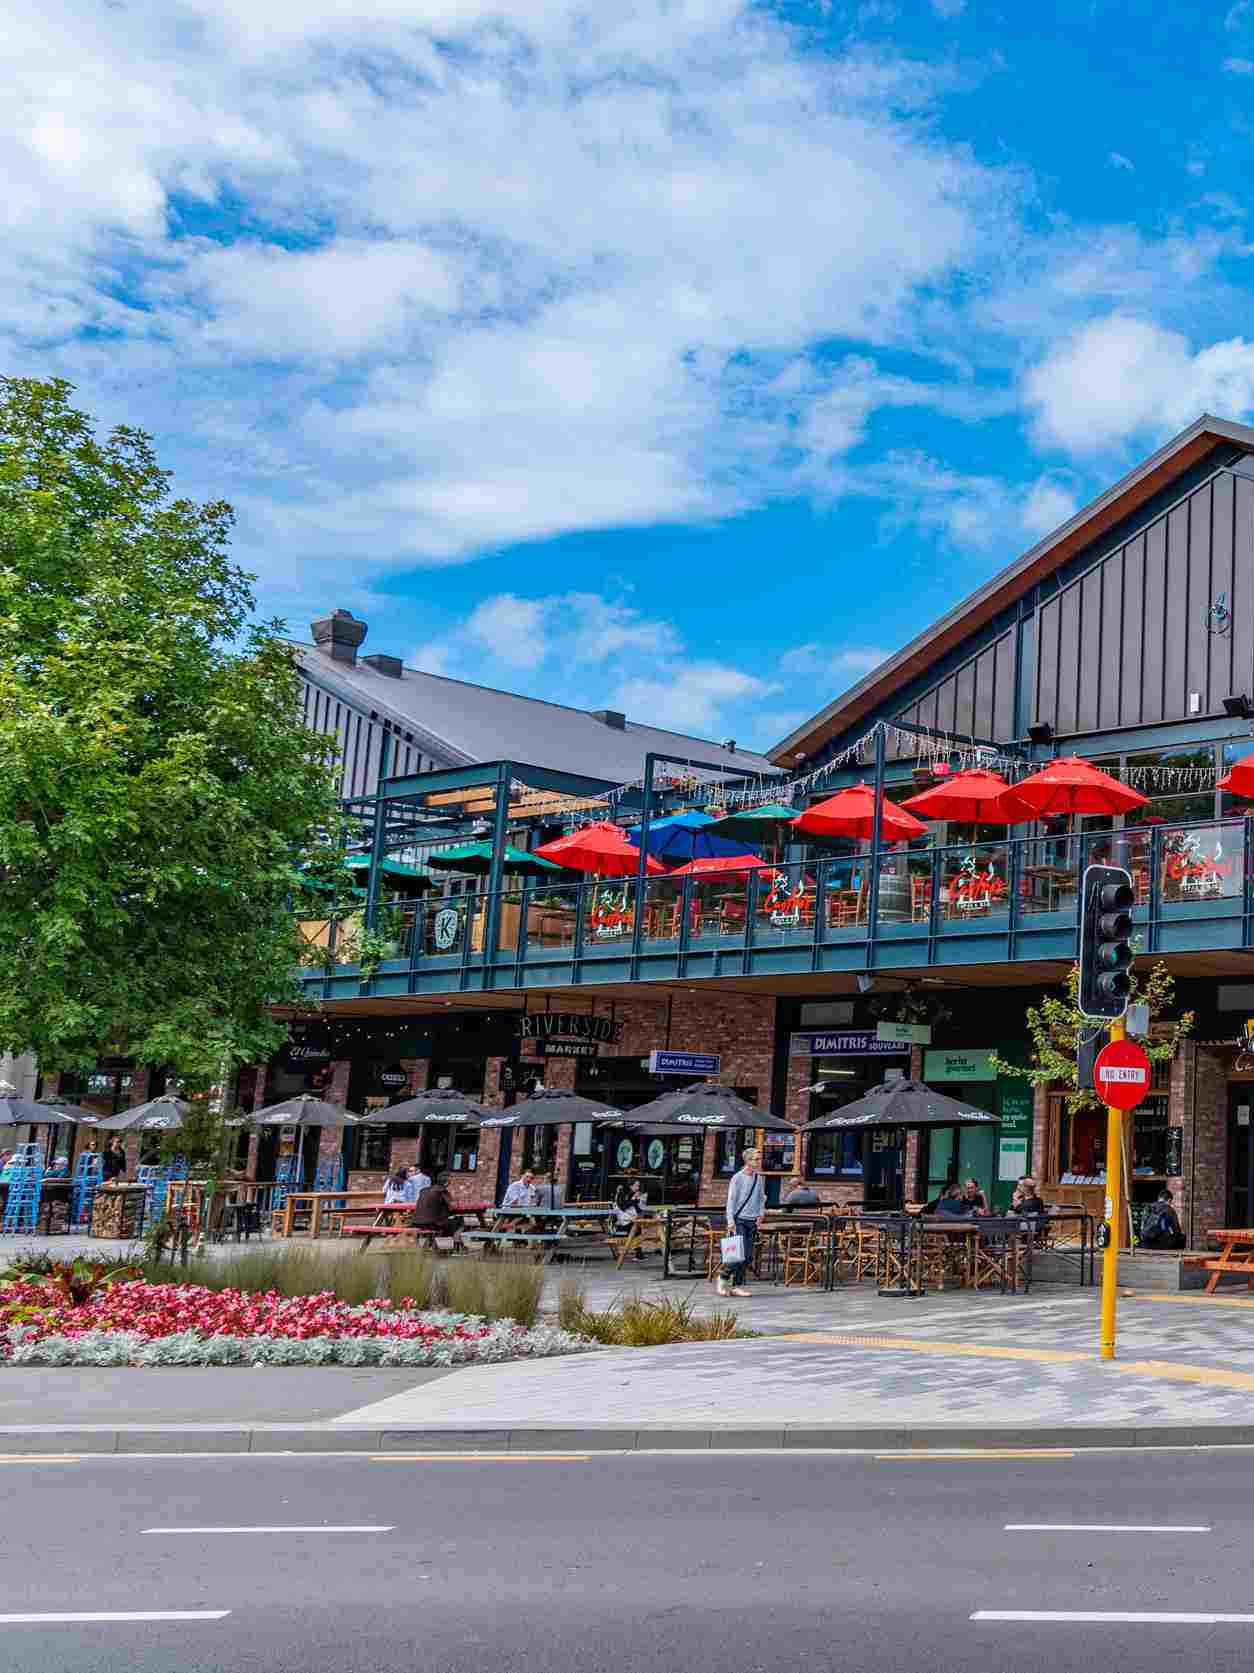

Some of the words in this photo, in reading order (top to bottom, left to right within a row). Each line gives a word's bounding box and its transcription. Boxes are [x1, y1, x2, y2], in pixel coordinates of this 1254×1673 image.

[520, 1015, 624, 1041] RIVERSIDE
[545, 1043, 594, 1055] MARKET
[815, 1035, 867, 1050] DIMITRIS
[1119, 1070, 1138, 1081] ENTRY
